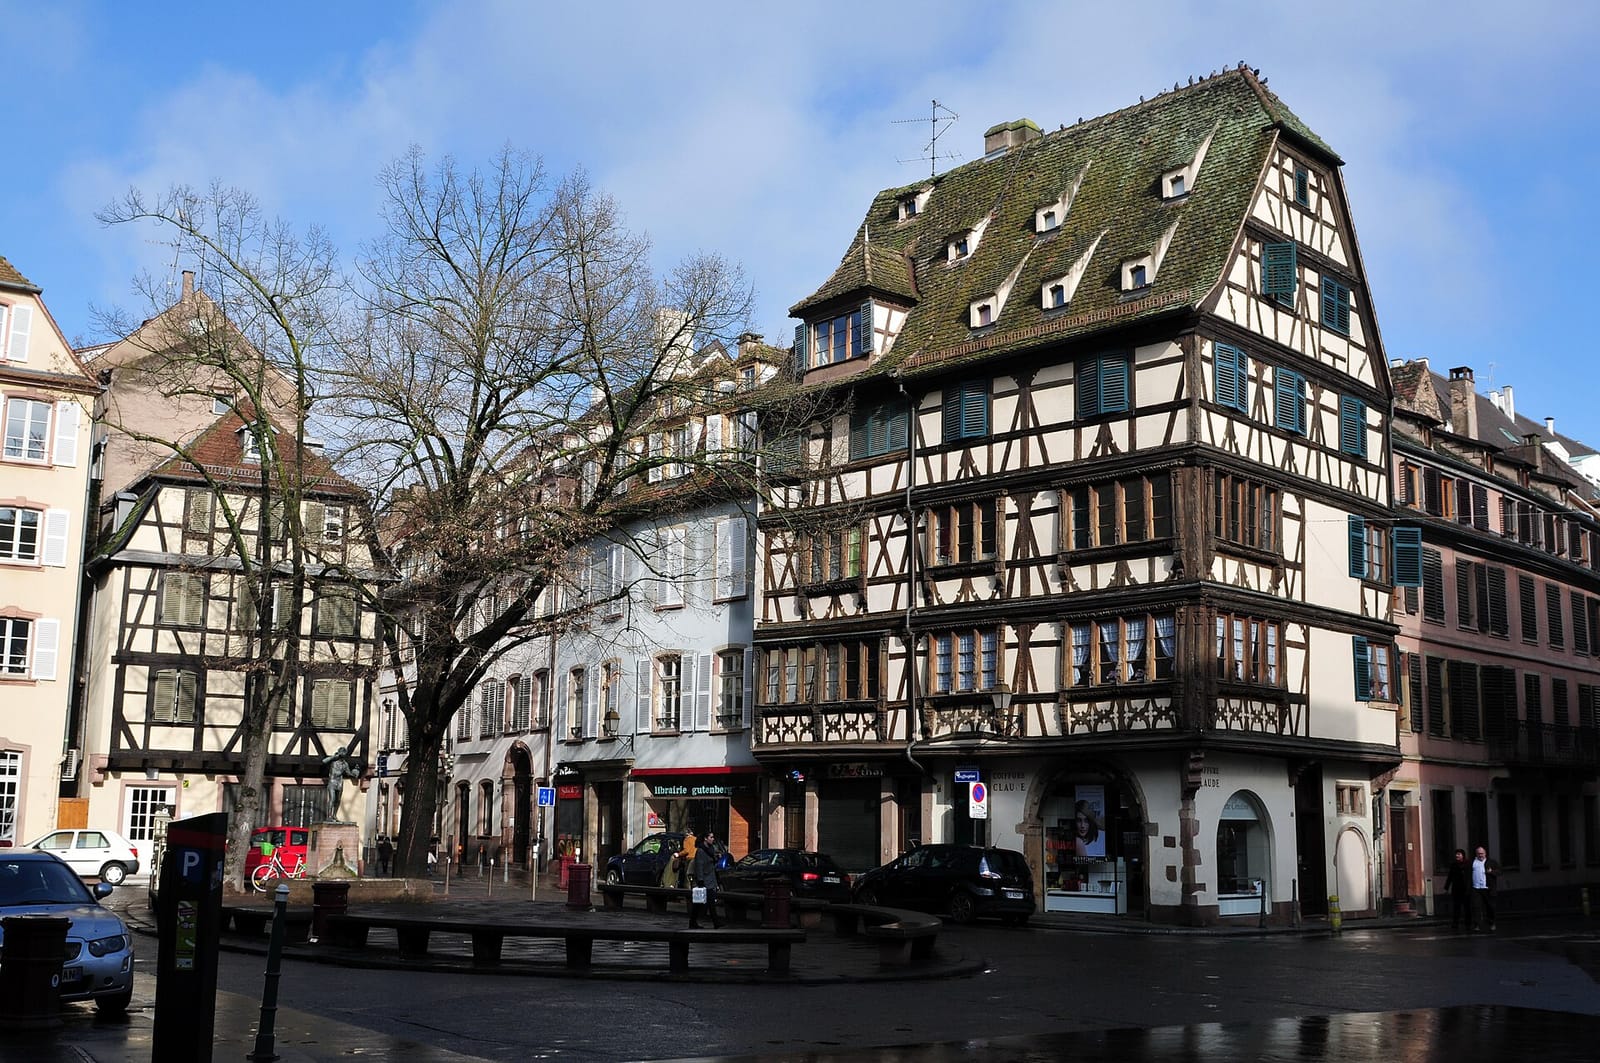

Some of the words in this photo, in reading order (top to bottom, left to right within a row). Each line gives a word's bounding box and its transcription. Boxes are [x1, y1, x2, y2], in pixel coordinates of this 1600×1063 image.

[992, 771, 1025, 780] COIFFURE
[654, 785, 688, 795] librairie
[691, 785, 733, 796] gutenberg
[993, 782, 1026, 791] CLAUE
[183, 851, 200, 877] P
